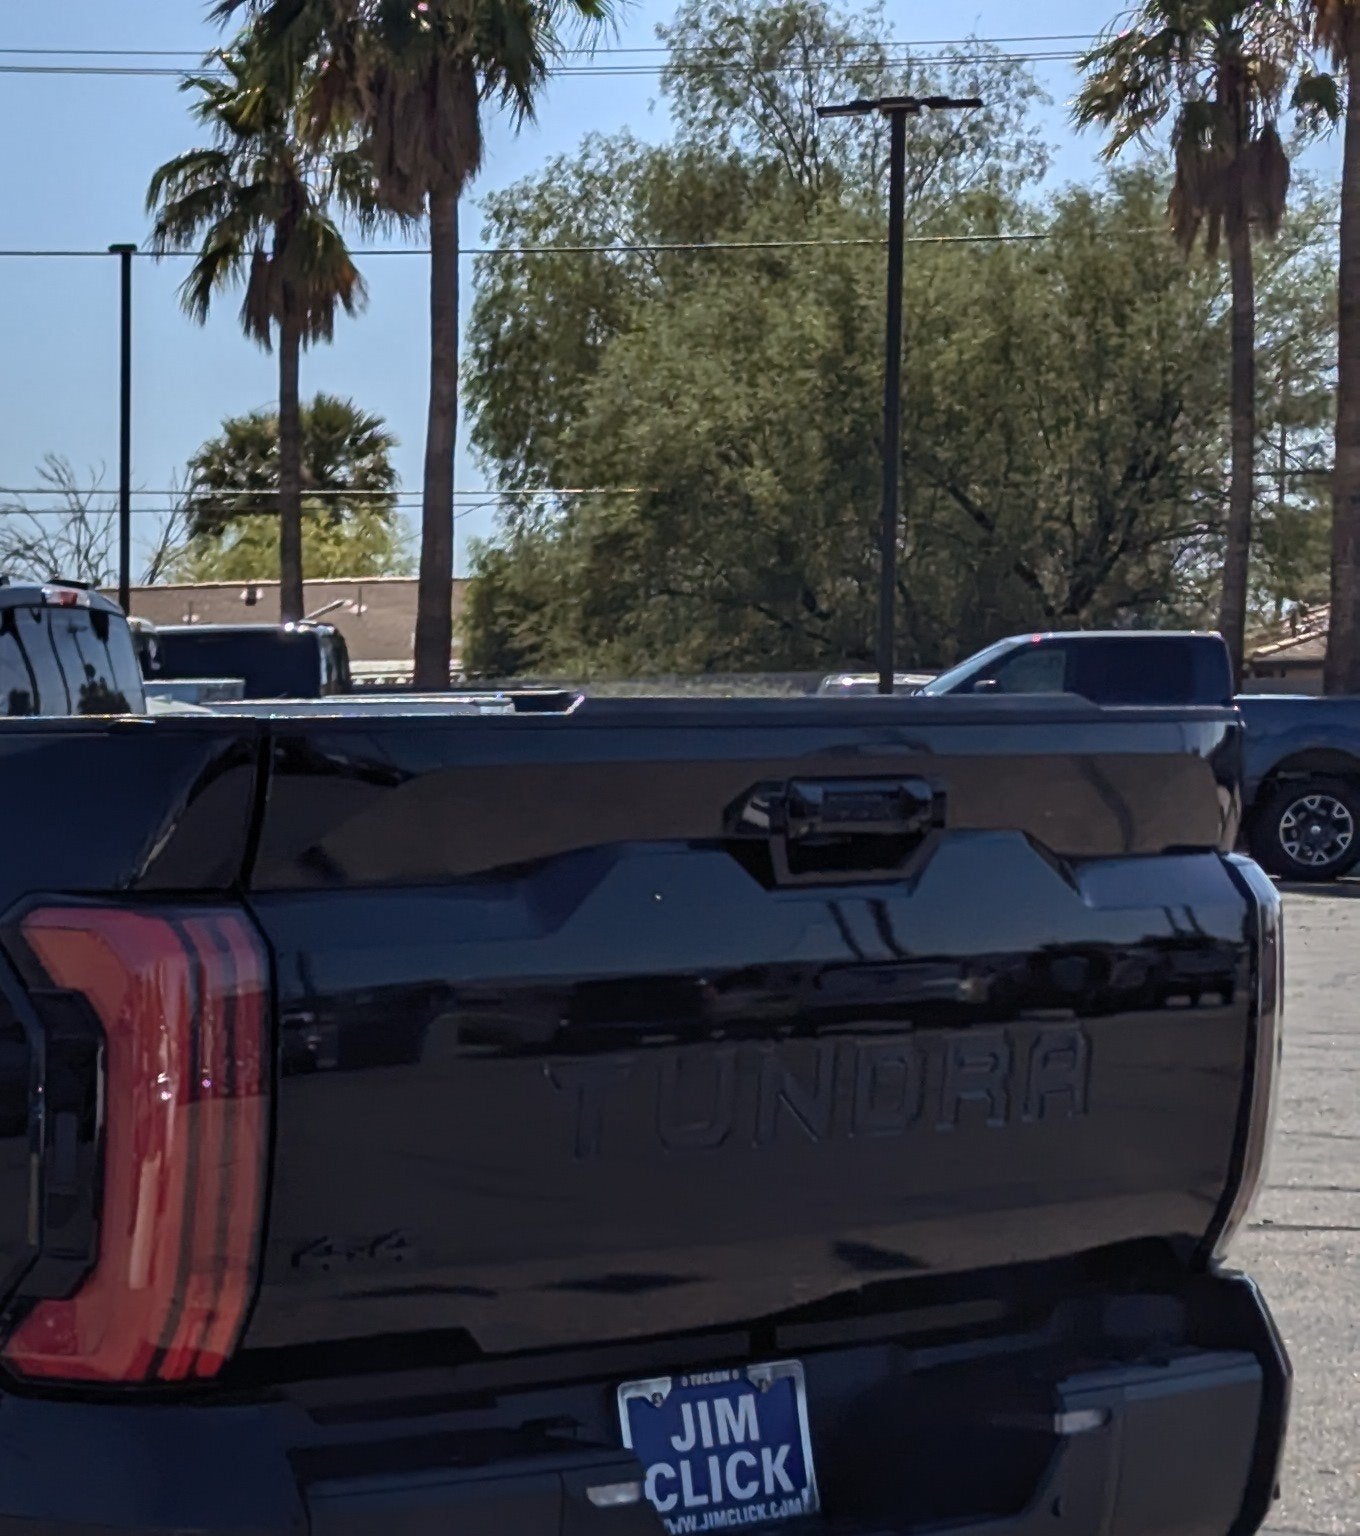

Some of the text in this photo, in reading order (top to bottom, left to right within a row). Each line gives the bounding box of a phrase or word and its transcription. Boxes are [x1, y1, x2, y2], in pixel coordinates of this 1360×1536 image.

[543, 1022, 1094, 1158] TUNDRA
[670, 1393, 761, 1452] JIM
[643, 1443, 796, 1513] CLICK
[663, 1497, 803, 1535] WW.JIMCLICK.COM
